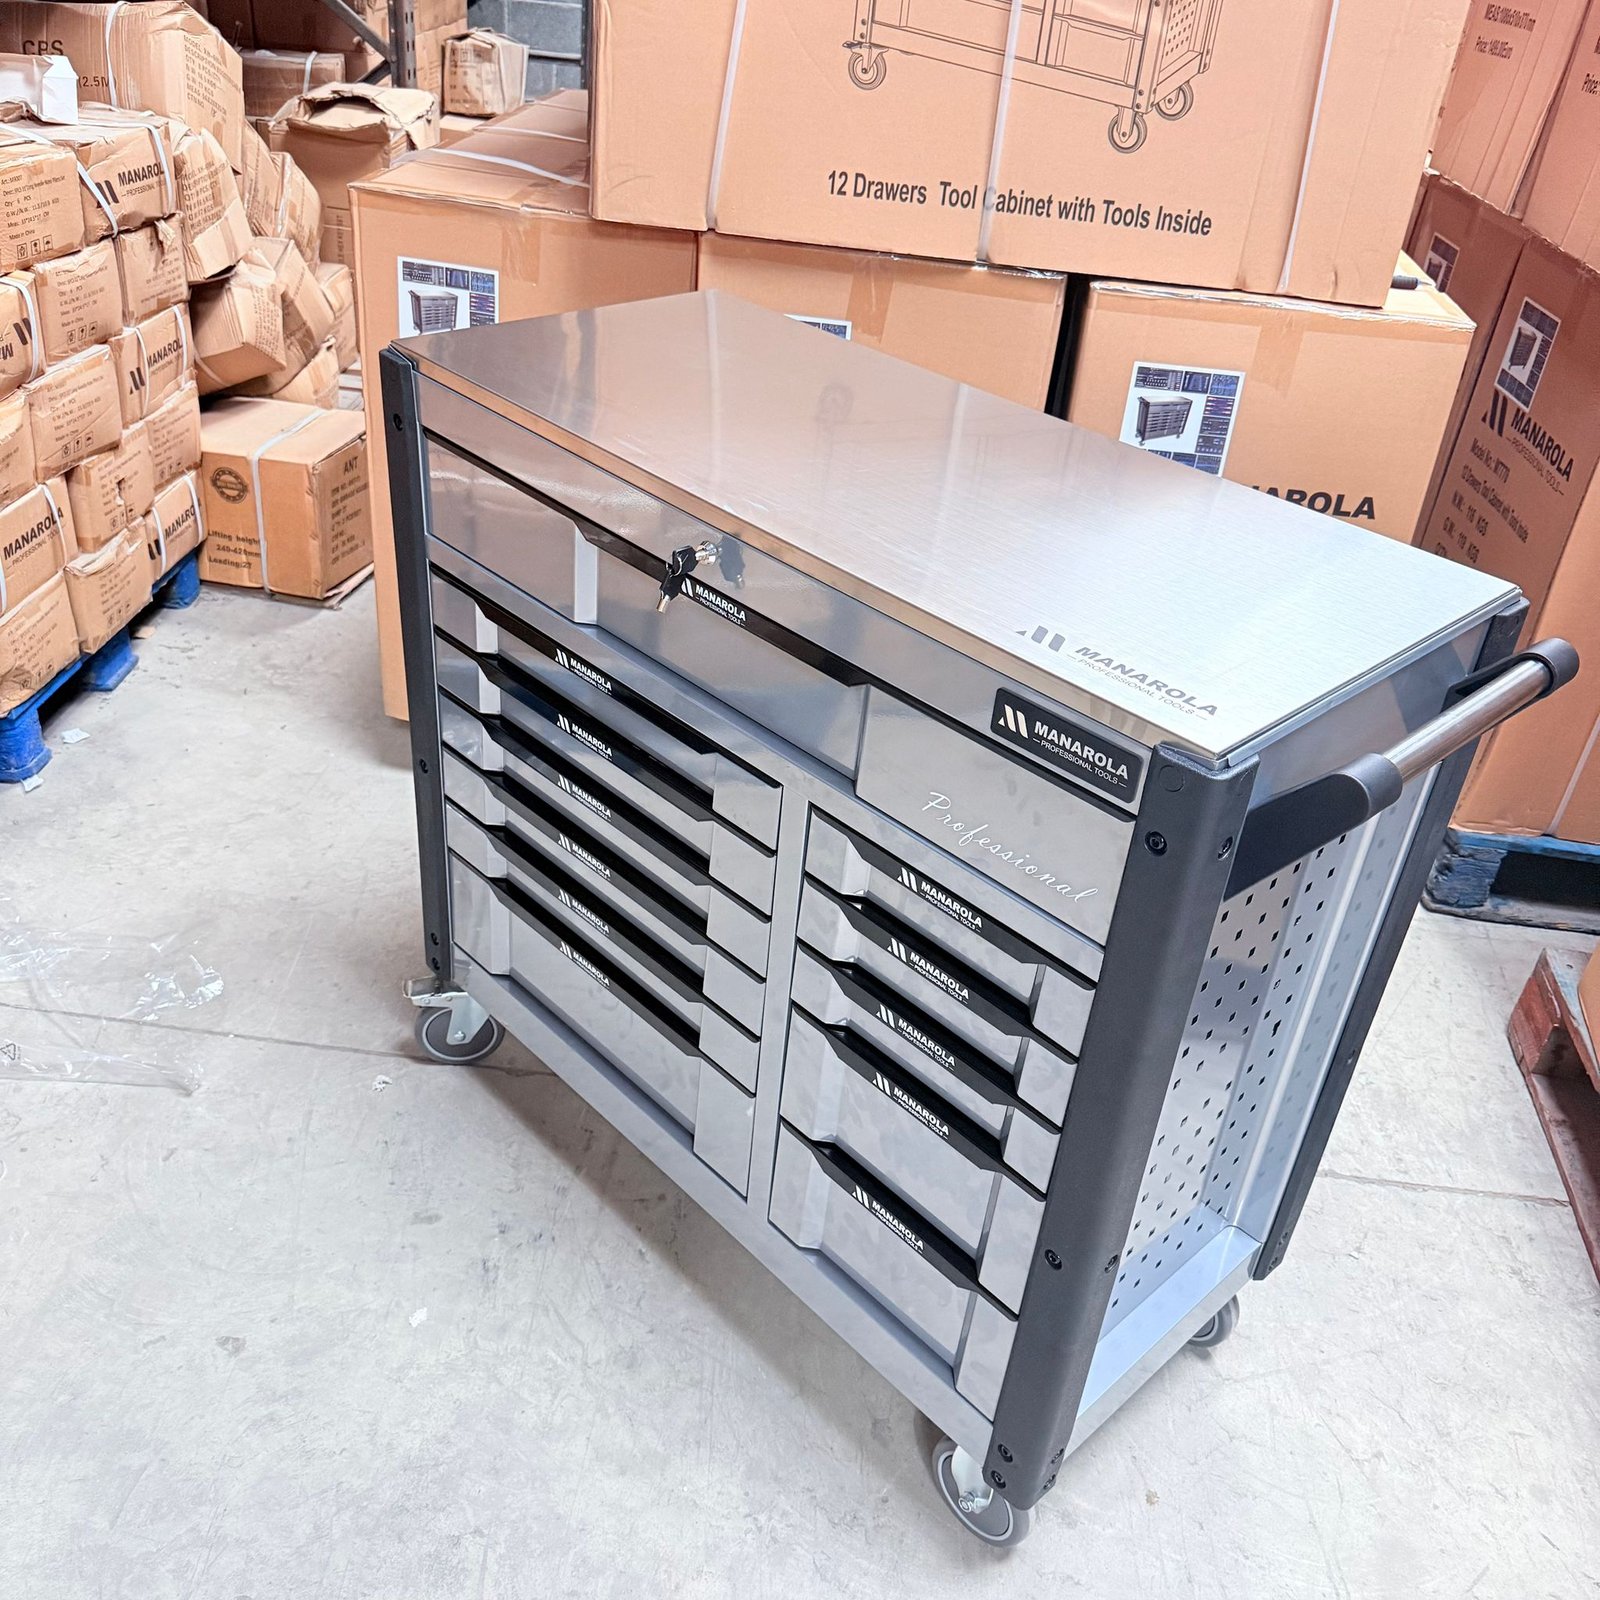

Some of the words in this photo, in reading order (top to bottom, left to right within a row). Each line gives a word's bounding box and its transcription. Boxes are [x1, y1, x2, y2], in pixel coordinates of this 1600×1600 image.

[118, 162, 164, 187] MANAROL
[827, 170, 847, 196] 12
[852, 173, 927, 205] Drawers
[939, 181, 978, 209] Tool
[1057, 197, 1096, 225] with
[1102, 200, 1151, 230] Tools
[1155, 205, 1212, 237] Inside
[146, 338, 183, 369] MANAROL
[1510, 408, 1574, 481] MANAROLA
[1252, 485, 1375, 520] ROLA
[3, 507, 64, 560] MANAROLA
[696, 584, 746, 621] MANAROLA
[570, 658, 612, 691] MANAROLA
[1074, 646, 1218, 716] MANAROLA
[1077, 658, 1155, 697] PROFESSIONAL
[1157, 695, 1195, 715] TOOLS
[572, 723, 612, 756] MANAROLA
[1034, 721, 1129, 780] MANAROLA
[1040, 740, 1093, 772] PROFESSIONAL
[1092, 767, 1118, 785] TOOLS
[572, 784, 611, 818] MANAROLA
[572, 843, 611, 877] MANAROLA
[922, 792, 1099, 903] Professional
[572, 899, 610, 933] MANAROLA
[921, 881, 982, 928] MANAROLA
[573, 951, 610, 986] MANAROLA
[910, 952, 969, 1000] MANAROLA
[898, 1018, 956, 1067] MANAROLA
[894, 1087, 949, 1136] MANAROLA
[872, 1200, 924, 1250] MANAROLA
